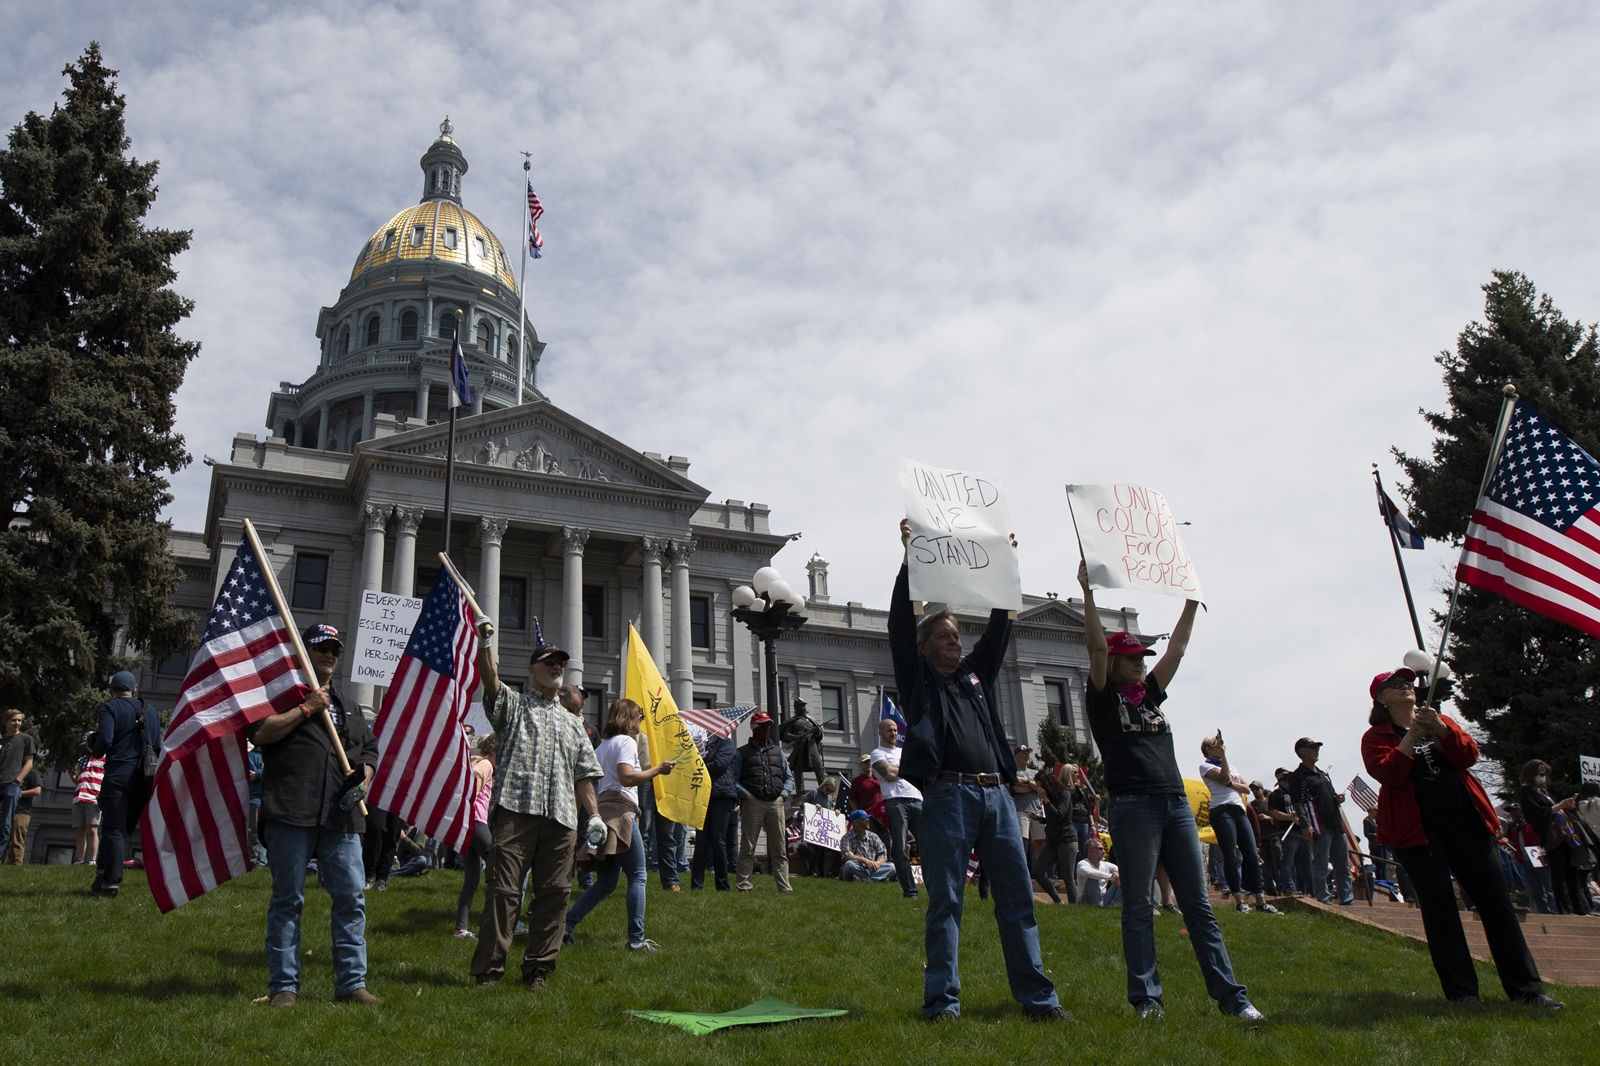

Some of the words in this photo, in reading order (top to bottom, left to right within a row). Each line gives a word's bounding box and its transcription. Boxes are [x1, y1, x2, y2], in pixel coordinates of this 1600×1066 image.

[914, 467, 998, 508] UNITED
[927, 502, 977, 532] WE
[909, 535, 989, 570] STAND
[1121, 555, 1197, 592] PEOPLE
[365, 593, 401, 607] EVERY
[402, 598, 421, 609] JOB
[380, 608, 396, 620] IS
[359, 618, 411, 636] ESSENTIAL
[371, 636, 383, 645] TO
[387, 639, 407, 650] THE
[364, 648, 402, 662] PERSON
[357, 665, 386, 679] DOING
[813, 808, 833, 822] ALL
[805, 816, 841, 835] WORKERS
